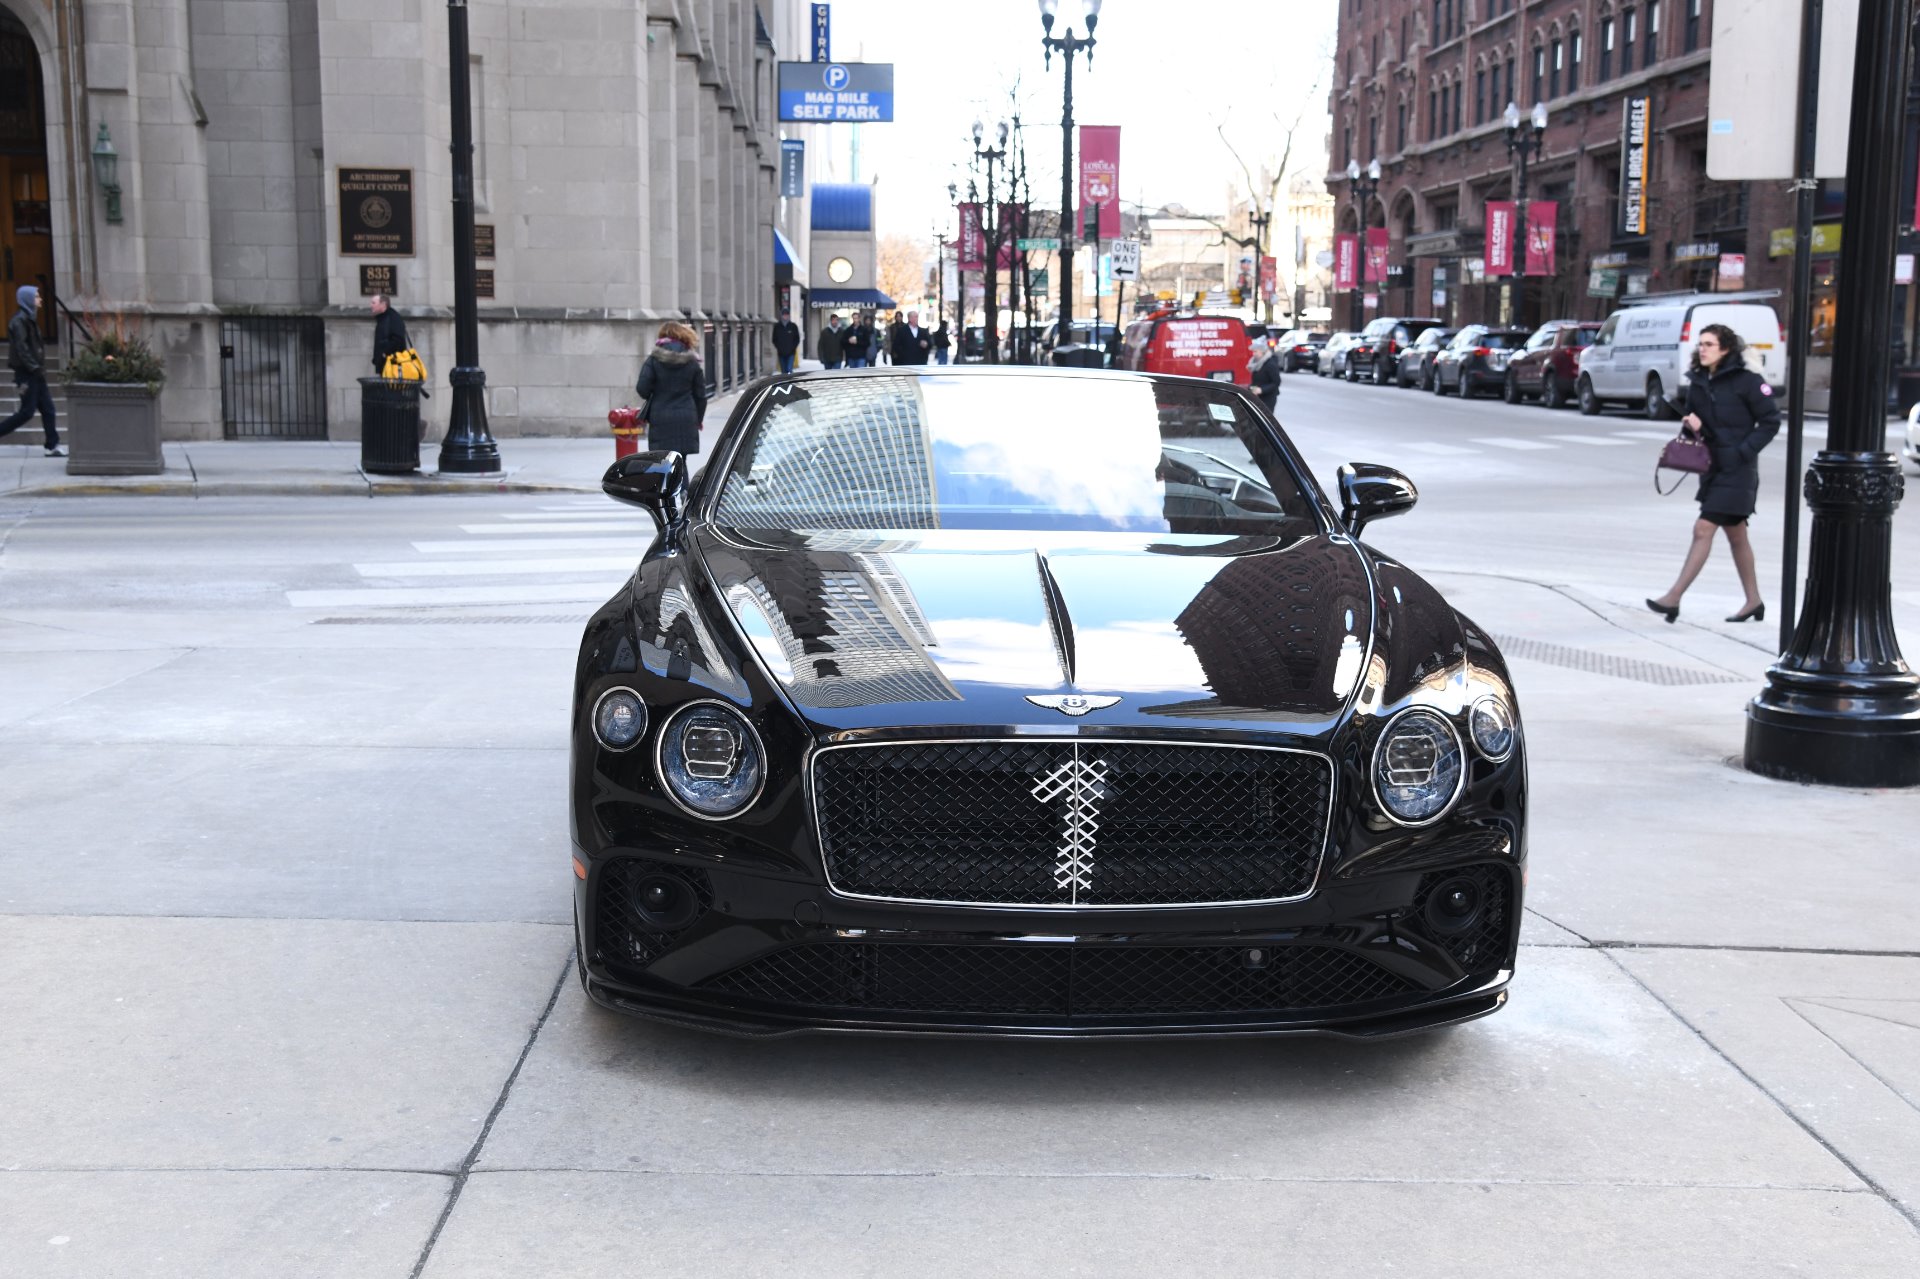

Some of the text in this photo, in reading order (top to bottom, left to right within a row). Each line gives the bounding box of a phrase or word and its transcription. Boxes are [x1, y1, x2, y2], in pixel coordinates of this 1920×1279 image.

[830, 67, 845, 87] P
[804, 92, 869, 104] MAG MILE
[793, 105, 880, 119] SELF PARK
[1630, 99, 1646, 144] BAGELS
[1083, 162, 1115, 170] LOYOLA
[350, 173, 400, 181] ARCHBISHOP
[341, 183, 409, 191] QUIGLEY CENTER
[1625, 179, 1642, 232] EINSTEIN
[1491, 210, 1502, 266] WELCOME
[1114, 242, 1137, 253] ONE
[1113, 255, 1137, 265] WAY
[367, 266, 390, 280] 835
[811, 301, 877, 309] GHIRARDELLI
[1184, 340, 1233, 348] PROTECTION
